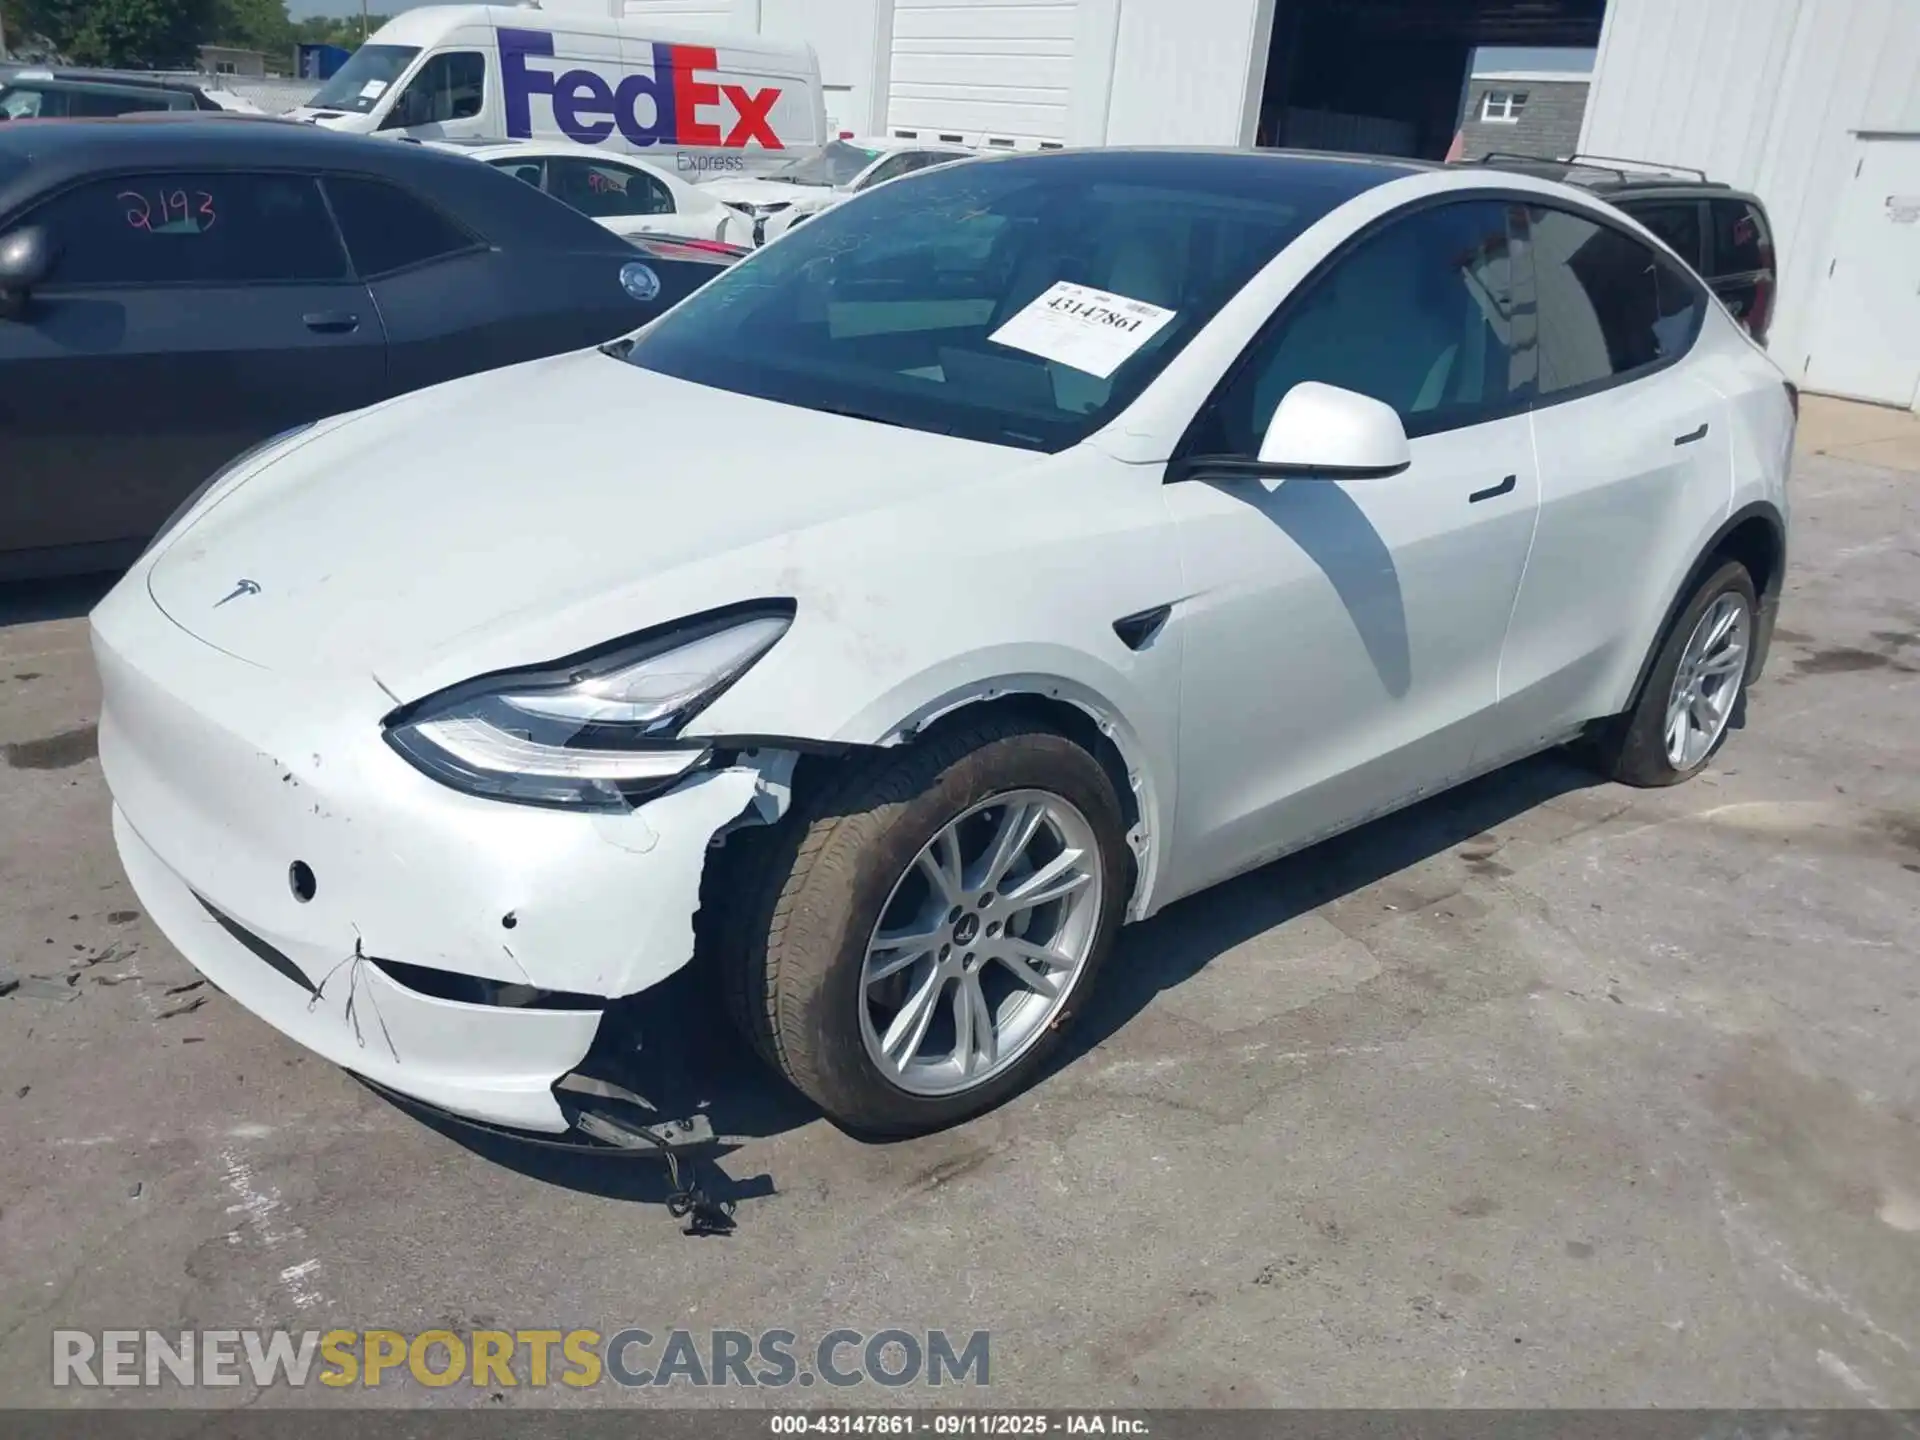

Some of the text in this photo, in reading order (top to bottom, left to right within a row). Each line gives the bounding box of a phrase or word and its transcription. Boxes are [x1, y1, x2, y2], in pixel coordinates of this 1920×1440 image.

[497, 27, 785, 150] FedEx
[676, 151, 744, 176] Express
[116, 188, 216, 232] 2193
[1047, 297, 1142, 332] 43147861
